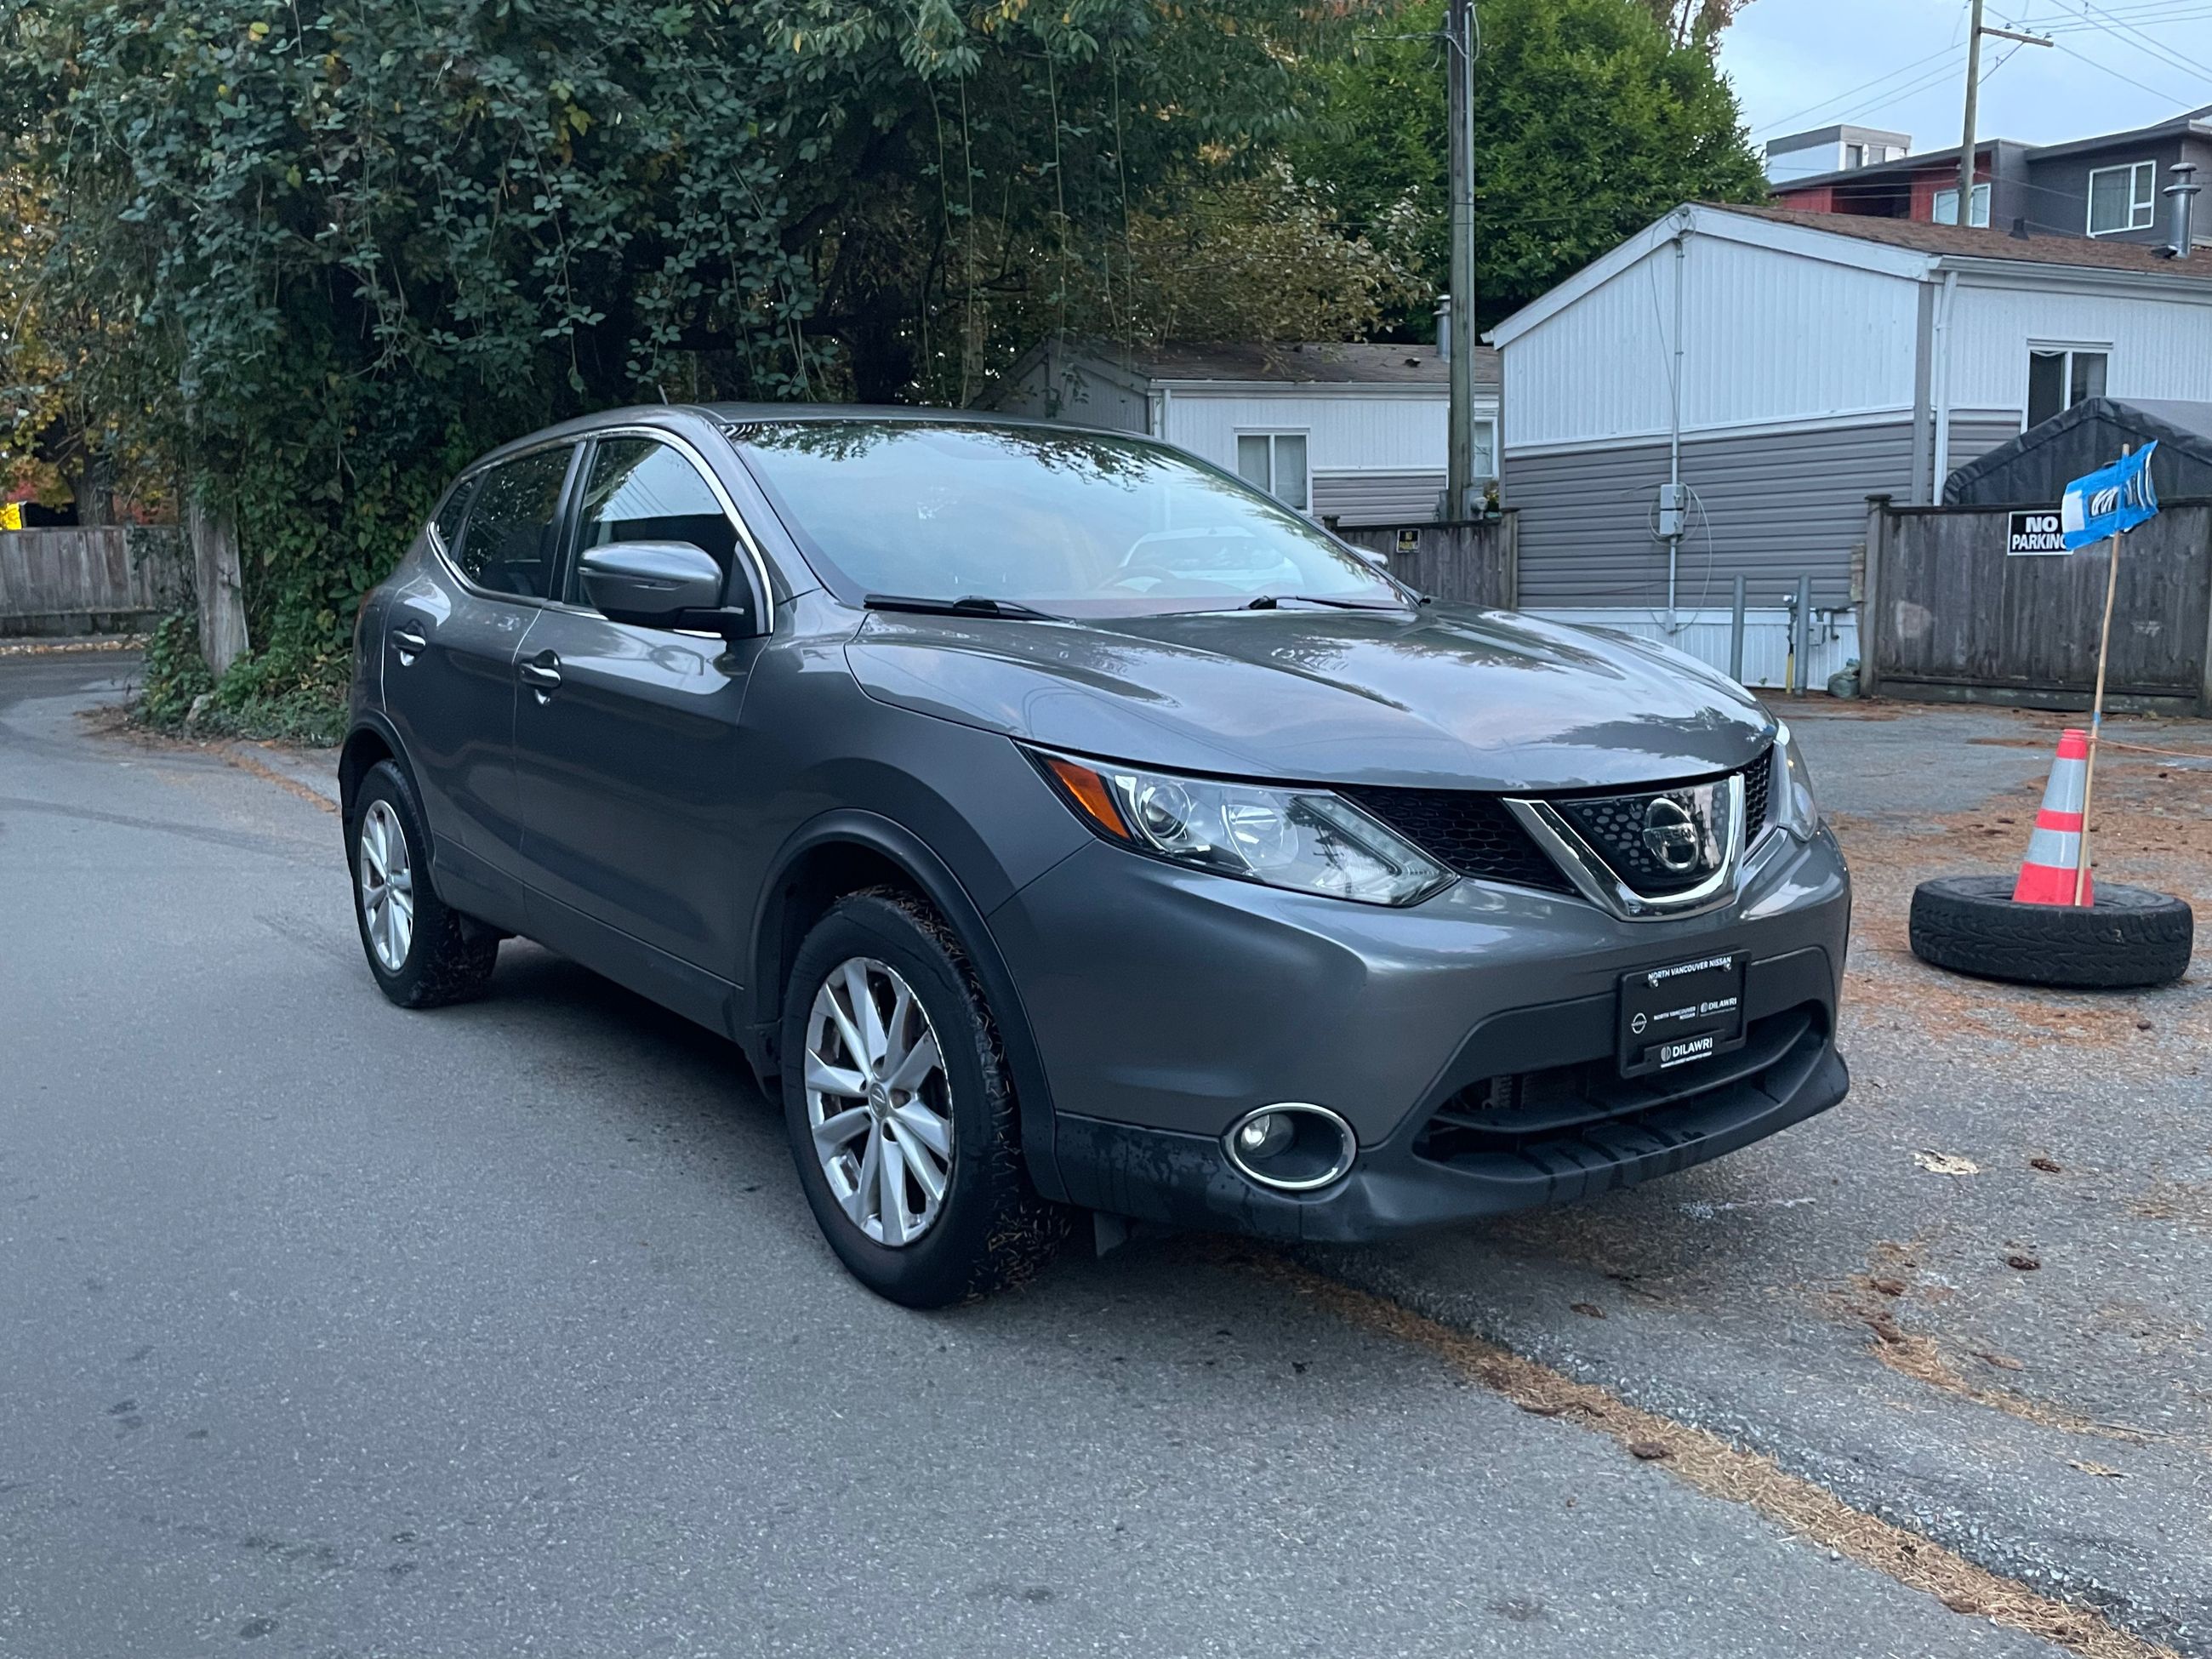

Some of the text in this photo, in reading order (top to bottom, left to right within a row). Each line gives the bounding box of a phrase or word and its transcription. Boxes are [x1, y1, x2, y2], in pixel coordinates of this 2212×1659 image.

[2026, 516, 2058, 533] NO
[1648, 956, 1731, 981] NORTH VANCOUVER NISSAN
[1708, 997, 1737, 1011] DILAWRI
[1673, 1037, 1713, 1058] DILAWRI
